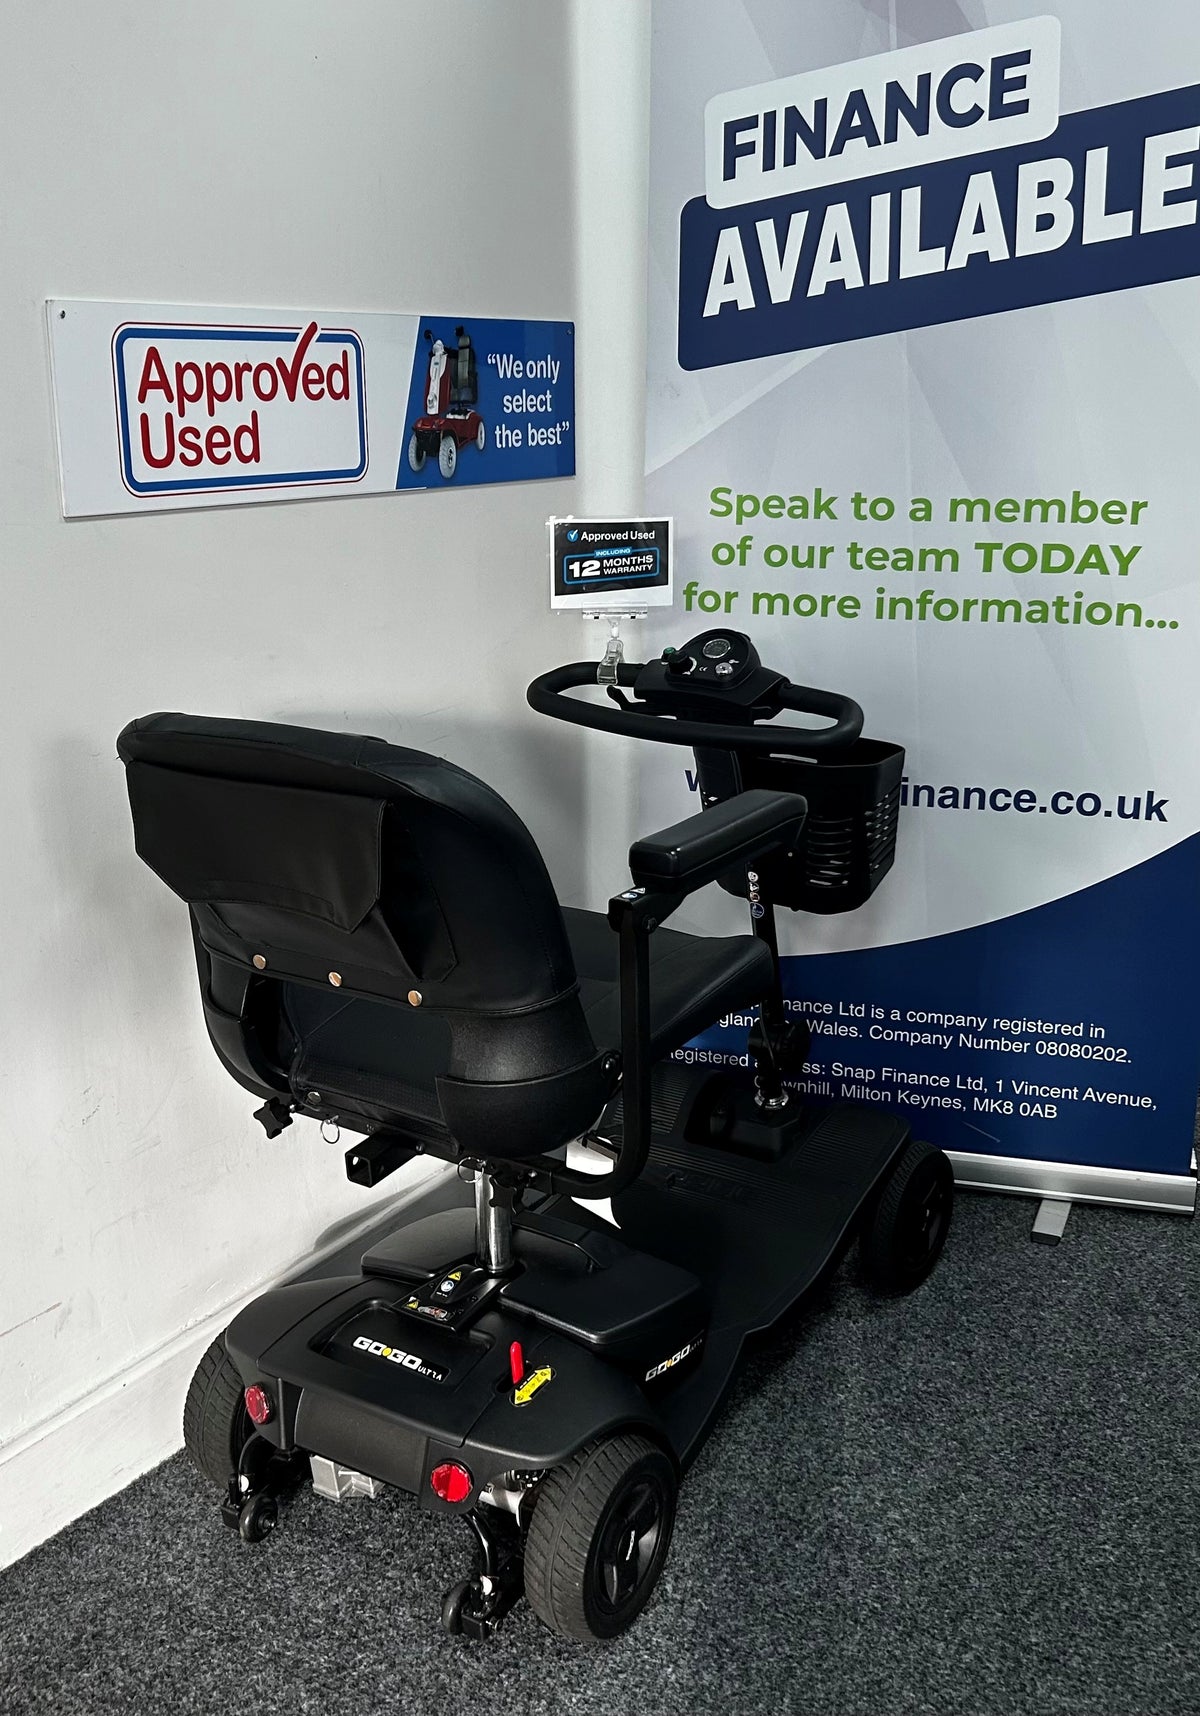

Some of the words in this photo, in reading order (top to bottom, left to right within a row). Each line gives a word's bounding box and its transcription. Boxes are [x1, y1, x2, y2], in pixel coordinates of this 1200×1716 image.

[723, 49, 1031, 181] FINANCE
[702, 127, 1200, 318] AVAILABLE
[137, 321, 350, 417] Approved
[526, 353, 560, 383] only
[502, 389, 552, 413] select
[139, 410, 260, 469] Used
[494, 427, 522, 448] the
[709, 487, 838, 525] Speak
[851, 491, 895, 521] to
[909, 497, 933, 522] a
[948, 491, 1149, 525] member
[580, 531, 628, 542] Approved
[630, 530, 655, 540] Used
[595, 548, 631, 556] INCLUDING
[711, 536, 752, 566] of
[763, 544, 834, 569] our
[847, 541, 960, 573] team
[974, 541, 1142, 576] TODAY
[568, 560, 600, 577] 12
[603, 555, 653, 567] MONTHS
[603, 563, 653, 575] WARRANTY
[682, 582, 739, 613] for
[751, 592, 861, 620] more
[875, 587, 1180, 630] information...
[900, 776, 1170, 823] inance.co.uk
[782, 999, 833, 1014] nance
[839, 1001, 865, 1018] Ltd
[871, 1004, 885, 1019] is
[890, 1009, 901, 1021] a
[906, 1010, 988, 1031] company
[993, 1017, 1084, 1037] registered
[1089, 1023, 1105, 1039] in
[806, 1019, 863, 1038] Wales.
[869, 1025, 953, 1049] Company
[959, 1033, 1031, 1053] Number
[1035, 1040, 1132, 1063] 08080202.
[670, 1047, 749, 1067] egistered
[831, 1062, 876, 1082] Snap
[882, 1067, 950, 1087] Finance
[956, 1074, 988, 1094] Ltd,
[995, 1079, 1003, 1093] 1
[1011, 1080, 1079, 1100] Vincent
[1082, 1087, 1157, 1111] Avenue,
[841, 1083, 891, 1102] Milton
[898, 1090, 966, 1112] Keynes,
[973, 1097, 1013, 1114] MK8
